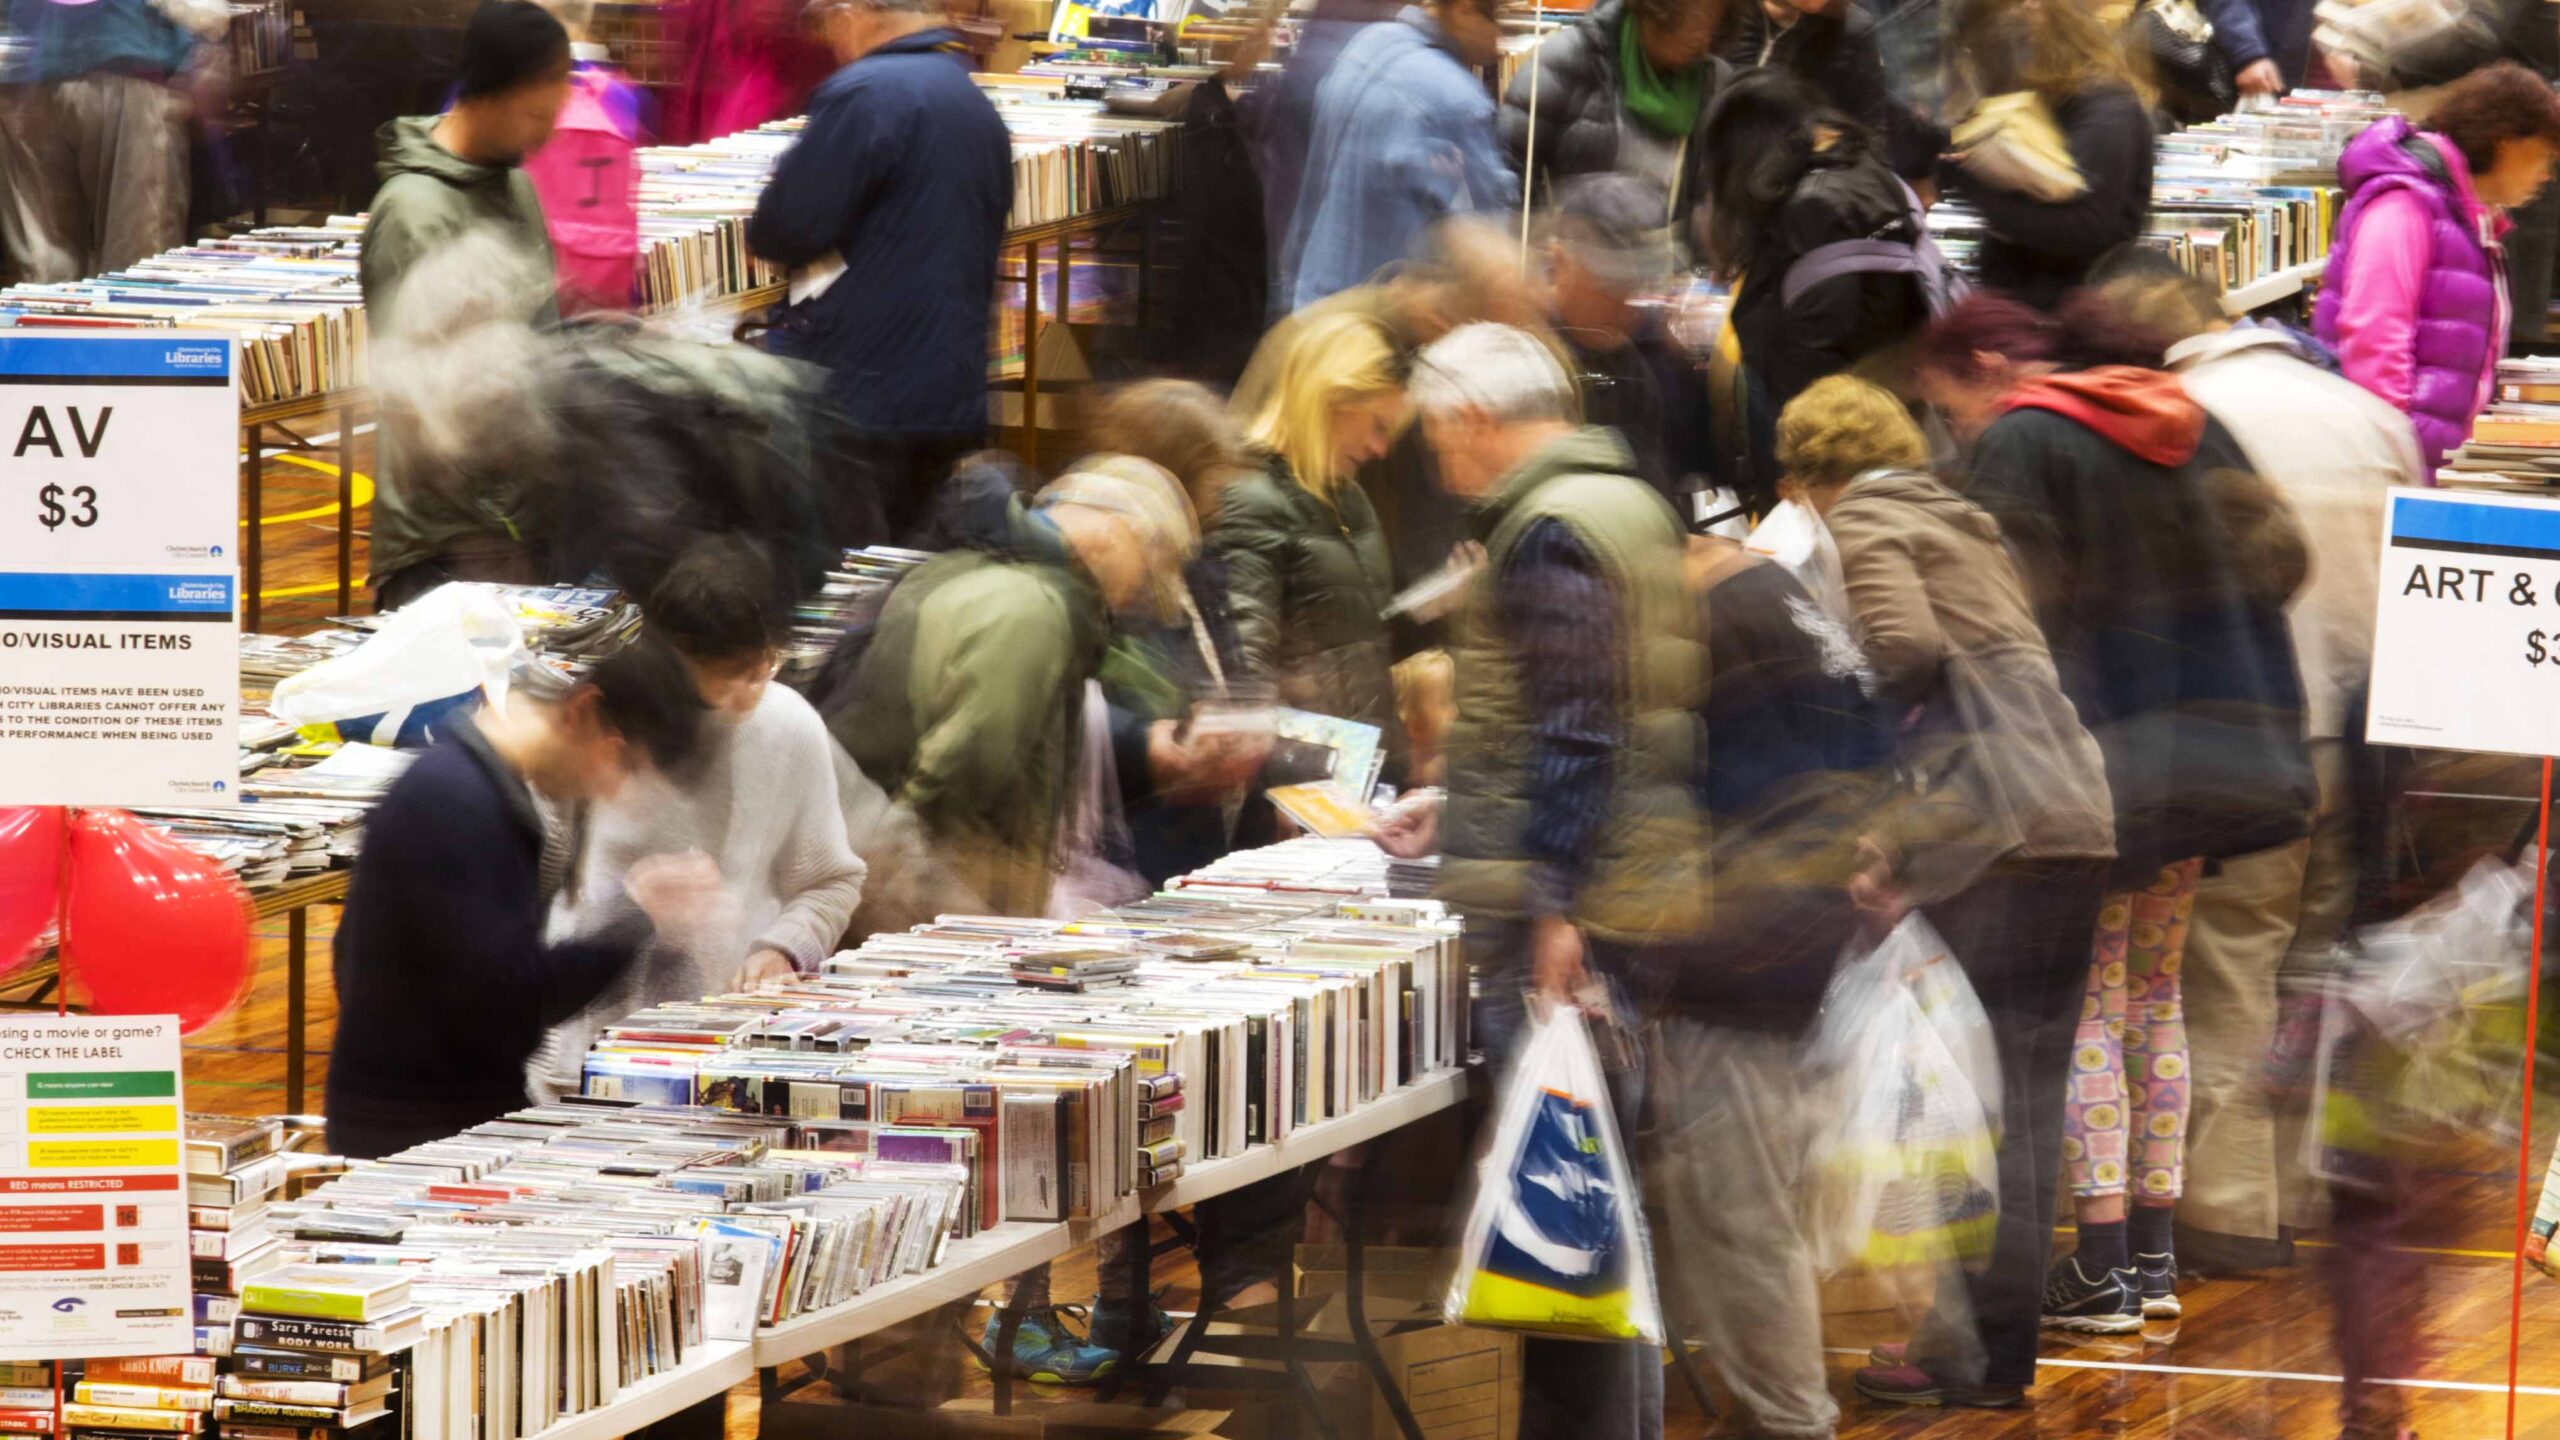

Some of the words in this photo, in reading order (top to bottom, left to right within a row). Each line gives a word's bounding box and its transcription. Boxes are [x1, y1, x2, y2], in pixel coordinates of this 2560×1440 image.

[165, 351, 223, 364] Libraries
[13, 405, 113, 458] AV
[38, 482, 99, 532] $3
[2403, 563, 2494, 602] ART
[2509, 572, 2537, 607] &
[169, 587, 226, 600] Libraries
[0, 632, 111, 650] O/VISUAL
[120, 633, 192, 650] ITEMS
[61, 687, 97, 697] ITEMS
[101, 687, 133, 697] HAVE
[138, 688, 168, 697] BEEN
[173, 688, 204, 697] USED
[8, 701, 34, 710] CITY
[39, 701, 101, 711] LIBRARIES
[105, 702, 154, 711] CANNOT
[159, 702, 196, 712] OFFER
[201, 703, 225, 712] ANY
[8, 715, 23, 724] TO
[28, 715, 50, 724] THE
[55, 716, 121, 725] CONDITION
[126, 716, 140, 725] OF
[145, 717, 182, 725] THESE
[187, 717, 222, 726] ITEMS
[9, 730, 98, 739] PERFORMANCE
[102, 731, 136, 740] WHEN
[141, 732, 177, 740] BEING
[182, 732, 213, 741] USED
[33, 1030, 42, 1038] a
[47, 1028, 90, 1038] movie
[95, 1030, 108, 1038] or
[112, 1026, 162, 1039] game?
[4, 1048, 50, 1059] CHECK
[56, 1048, 79, 1058] THE
[84, 1047, 123, 1058] LABEL
[10, 1181, 28, 1190] RED
[31, 1182, 65, 1190] means
[68, 1179, 124, 1189] RESTRICTED
[271, 1321, 299, 1333] Sara
[278, 1337, 312, 1347] BODY
[315, 1340, 351, 1350] WORK
[268, 1363, 303, 1374] BURKE
